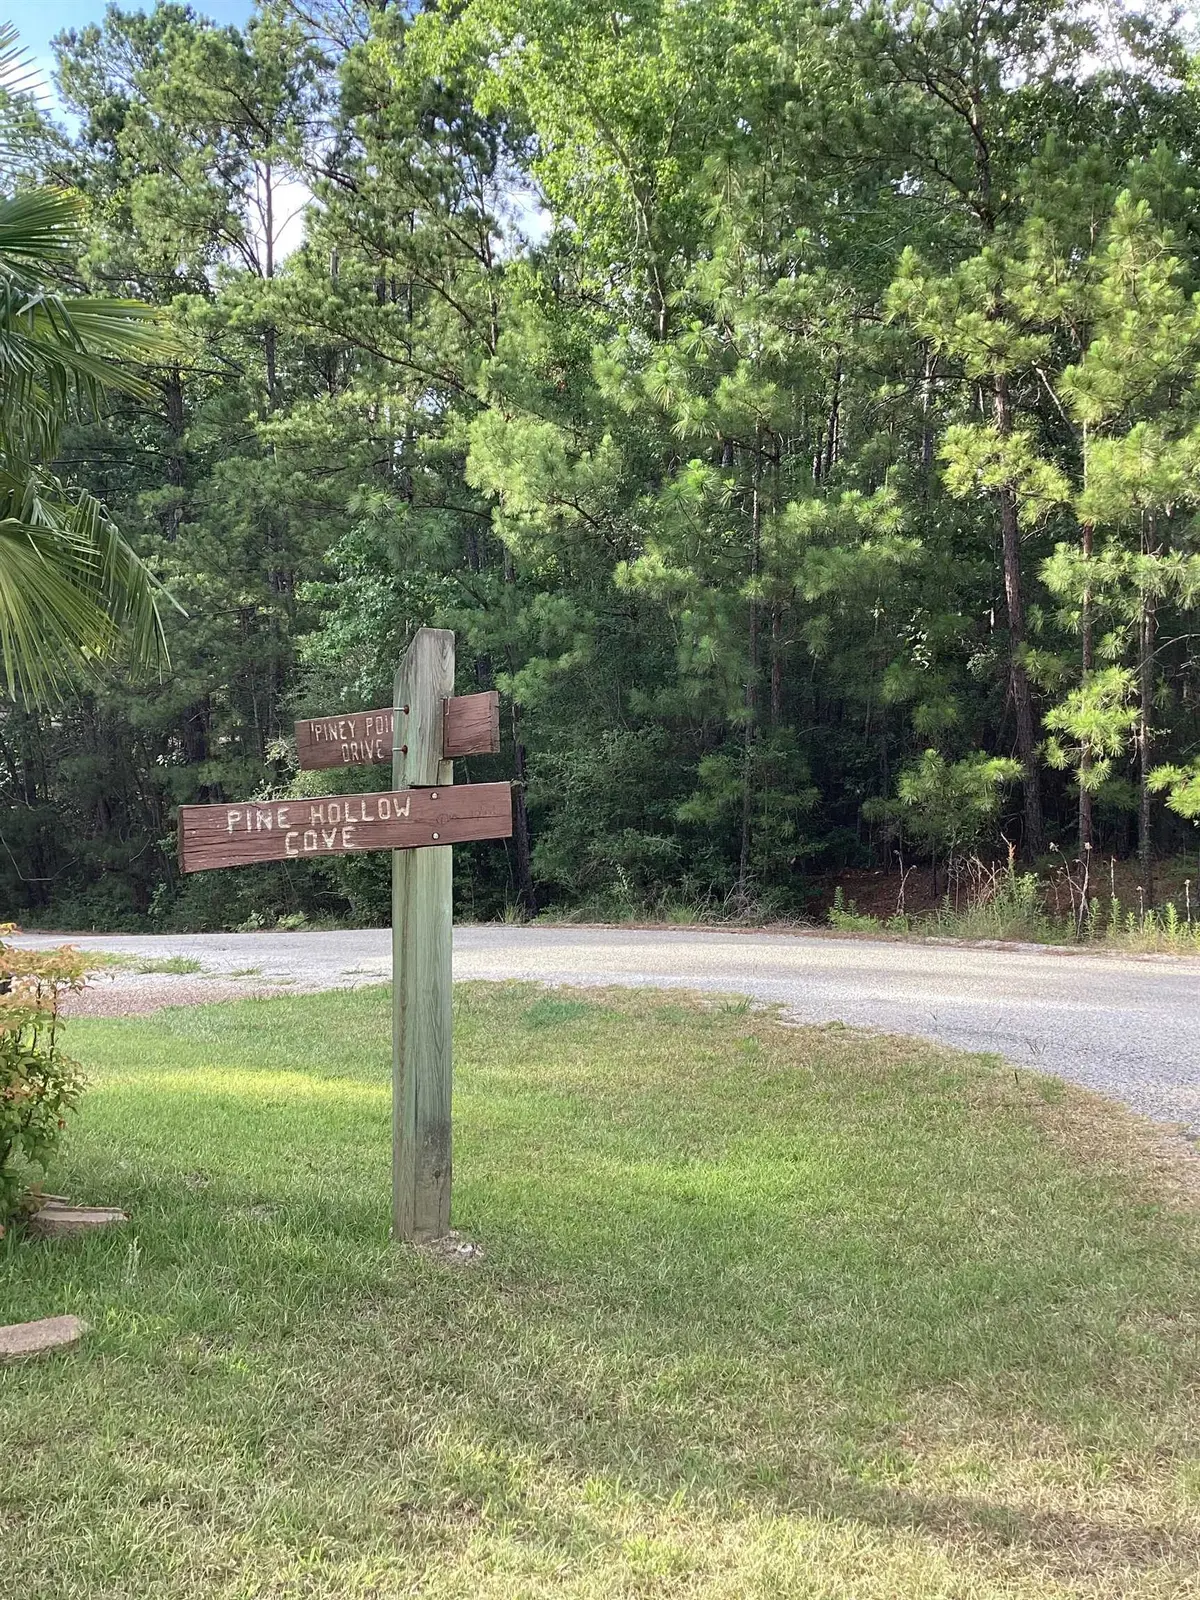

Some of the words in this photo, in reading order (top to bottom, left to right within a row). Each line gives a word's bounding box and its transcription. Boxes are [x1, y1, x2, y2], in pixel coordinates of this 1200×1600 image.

[314, 720, 355, 741] PINEY
[366, 714, 394, 736] POI
[341, 739, 384, 762] DRIVE
[226, 807, 291, 834] PINE
[309, 796, 411, 827] HOLLOW
[284, 825, 355, 857] COVE
